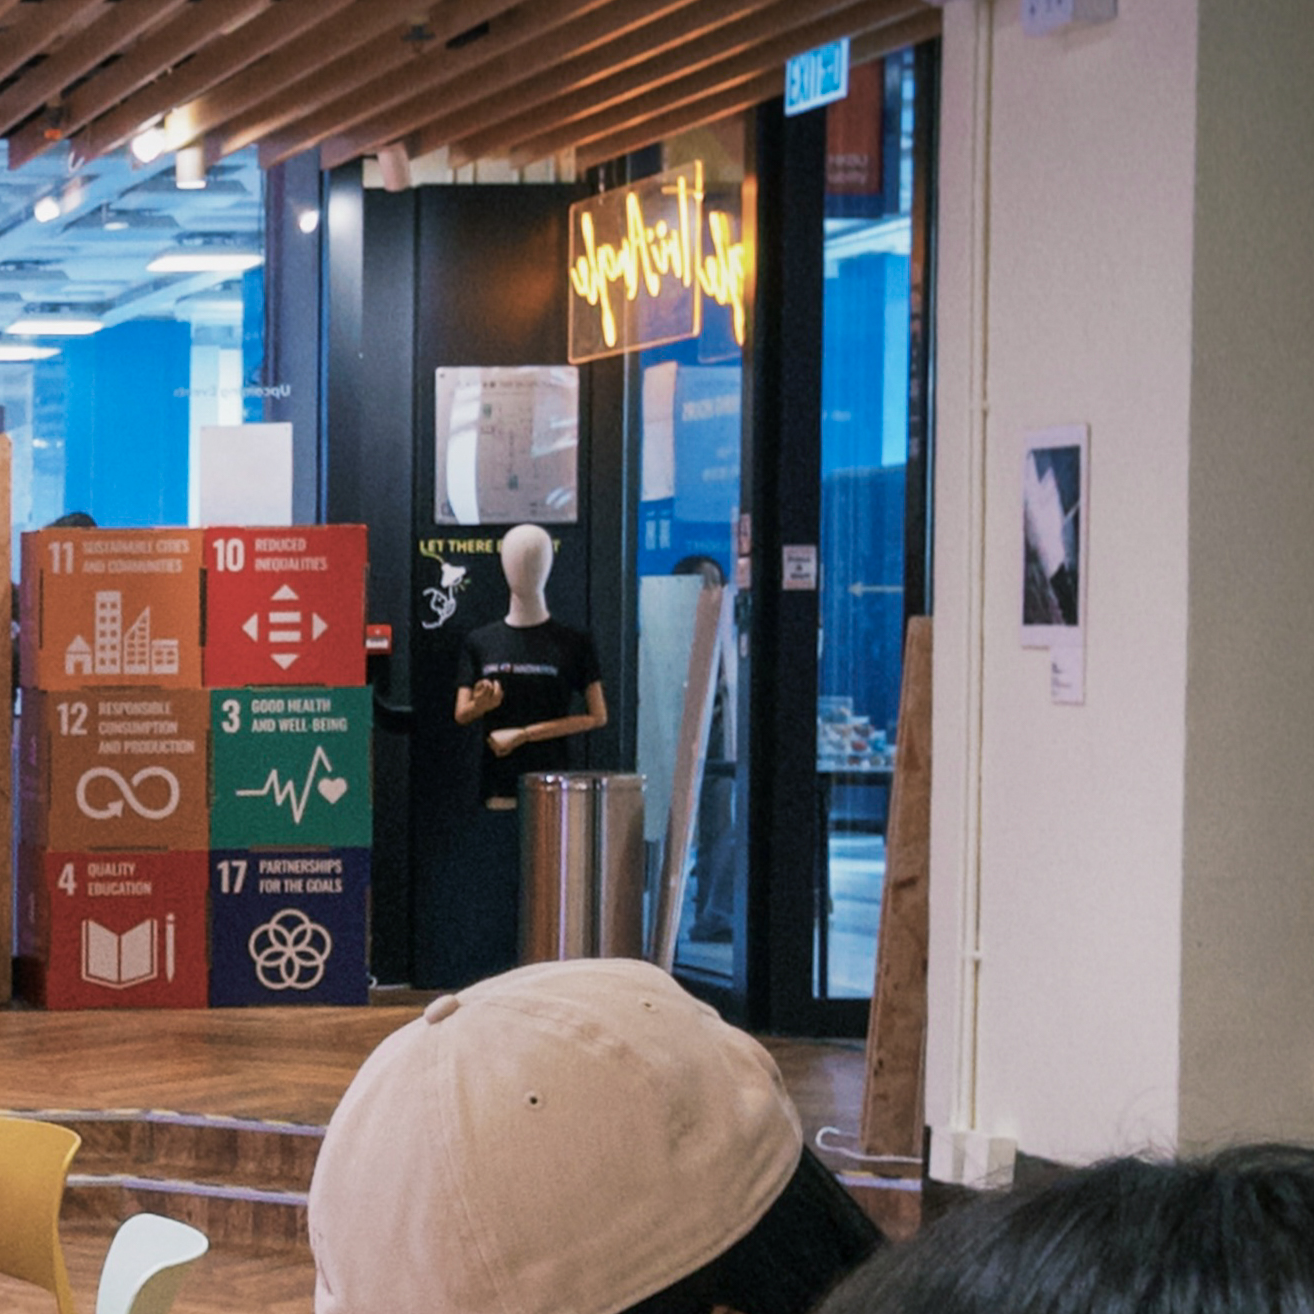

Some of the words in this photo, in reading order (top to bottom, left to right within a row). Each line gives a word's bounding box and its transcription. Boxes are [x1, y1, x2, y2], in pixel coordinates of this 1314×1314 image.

[48, 541, 74, 574] 11
[212, 538, 245, 572] 10
[255, 538, 306, 552] REDUCED
[419, 539, 445, 554] LET
[448, 539, 493, 554] THERE
[254, 557, 328, 572] INEQUALITIES
[56, 702, 89, 736] 12
[222, 699, 241, 733] 3
[251, 700, 284, 714] GOOD
[288, 698, 331, 713] HEALTH
[251, 718, 276, 732] AND
[279, 718, 348, 732] WELL-BEING
[57, 862, 78, 896] 4
[87, 862, 136, 877] QUALITY
[87, 881, 152, 896] EDUCATION
[216, 859, 248, 894] 17
[259, 859, 343, 874] PARTNERSHIPS
[259, 879, 281, 894] FOR
[284, 879, 303, 893] THE
[306, 878, 343, 893] GOALS
